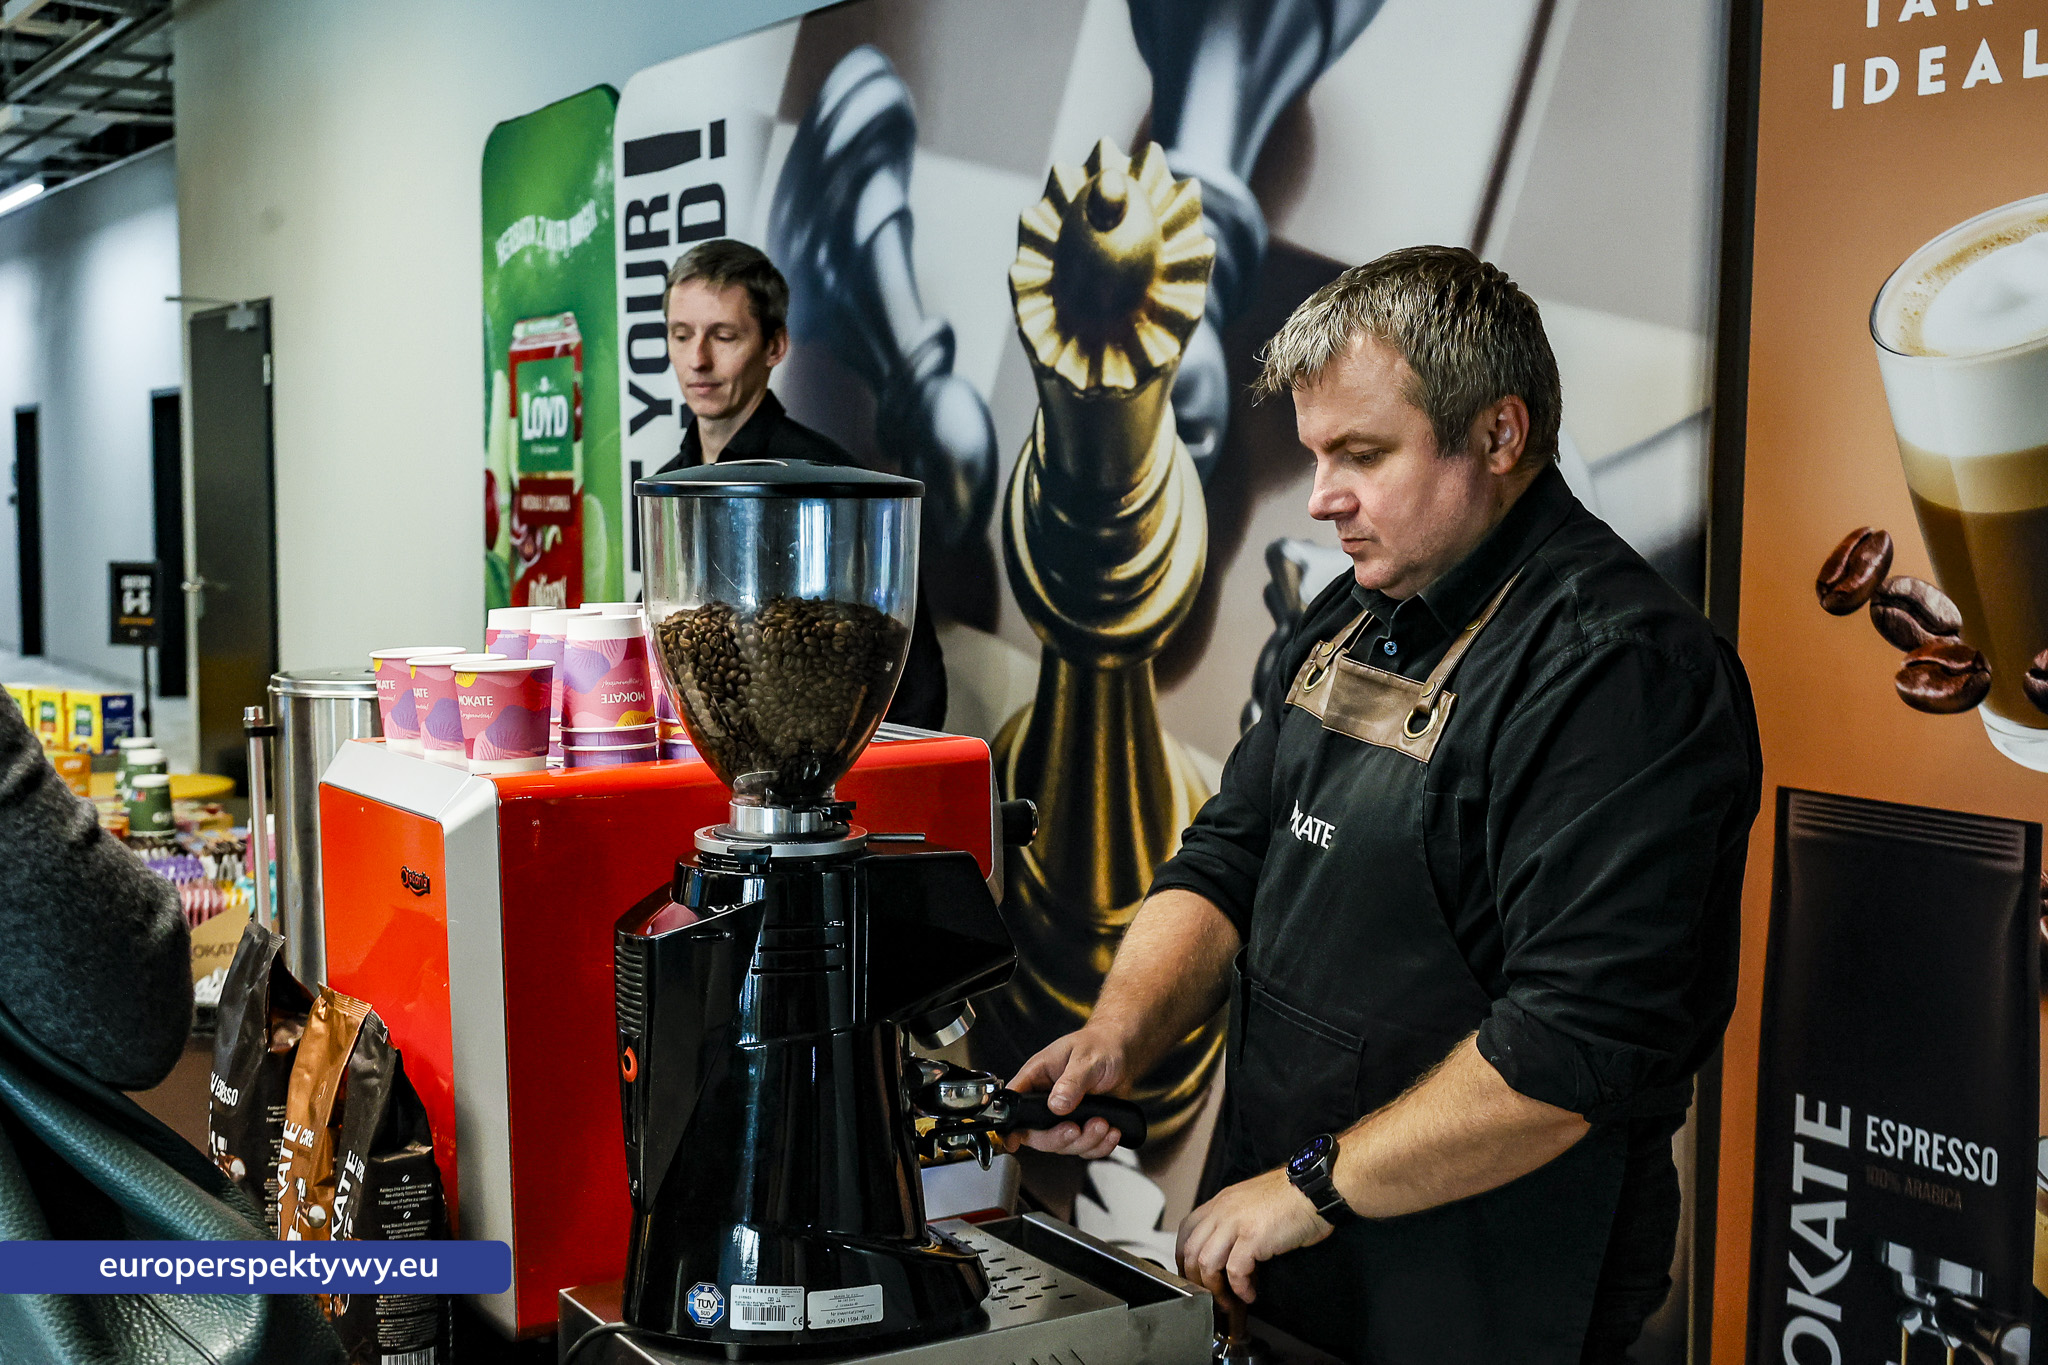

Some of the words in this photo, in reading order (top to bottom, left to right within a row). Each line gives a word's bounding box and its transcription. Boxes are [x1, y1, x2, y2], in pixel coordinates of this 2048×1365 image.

[1832, 29, 2048, 109] IDEAL
[600, 691, 646, 704] MOKATE
[192, 942, 238, 959] OKAT
[1866, 1115, 1999, 1187] ESPRESSO
[1782, 1093, 1852, 1365] OKATE
